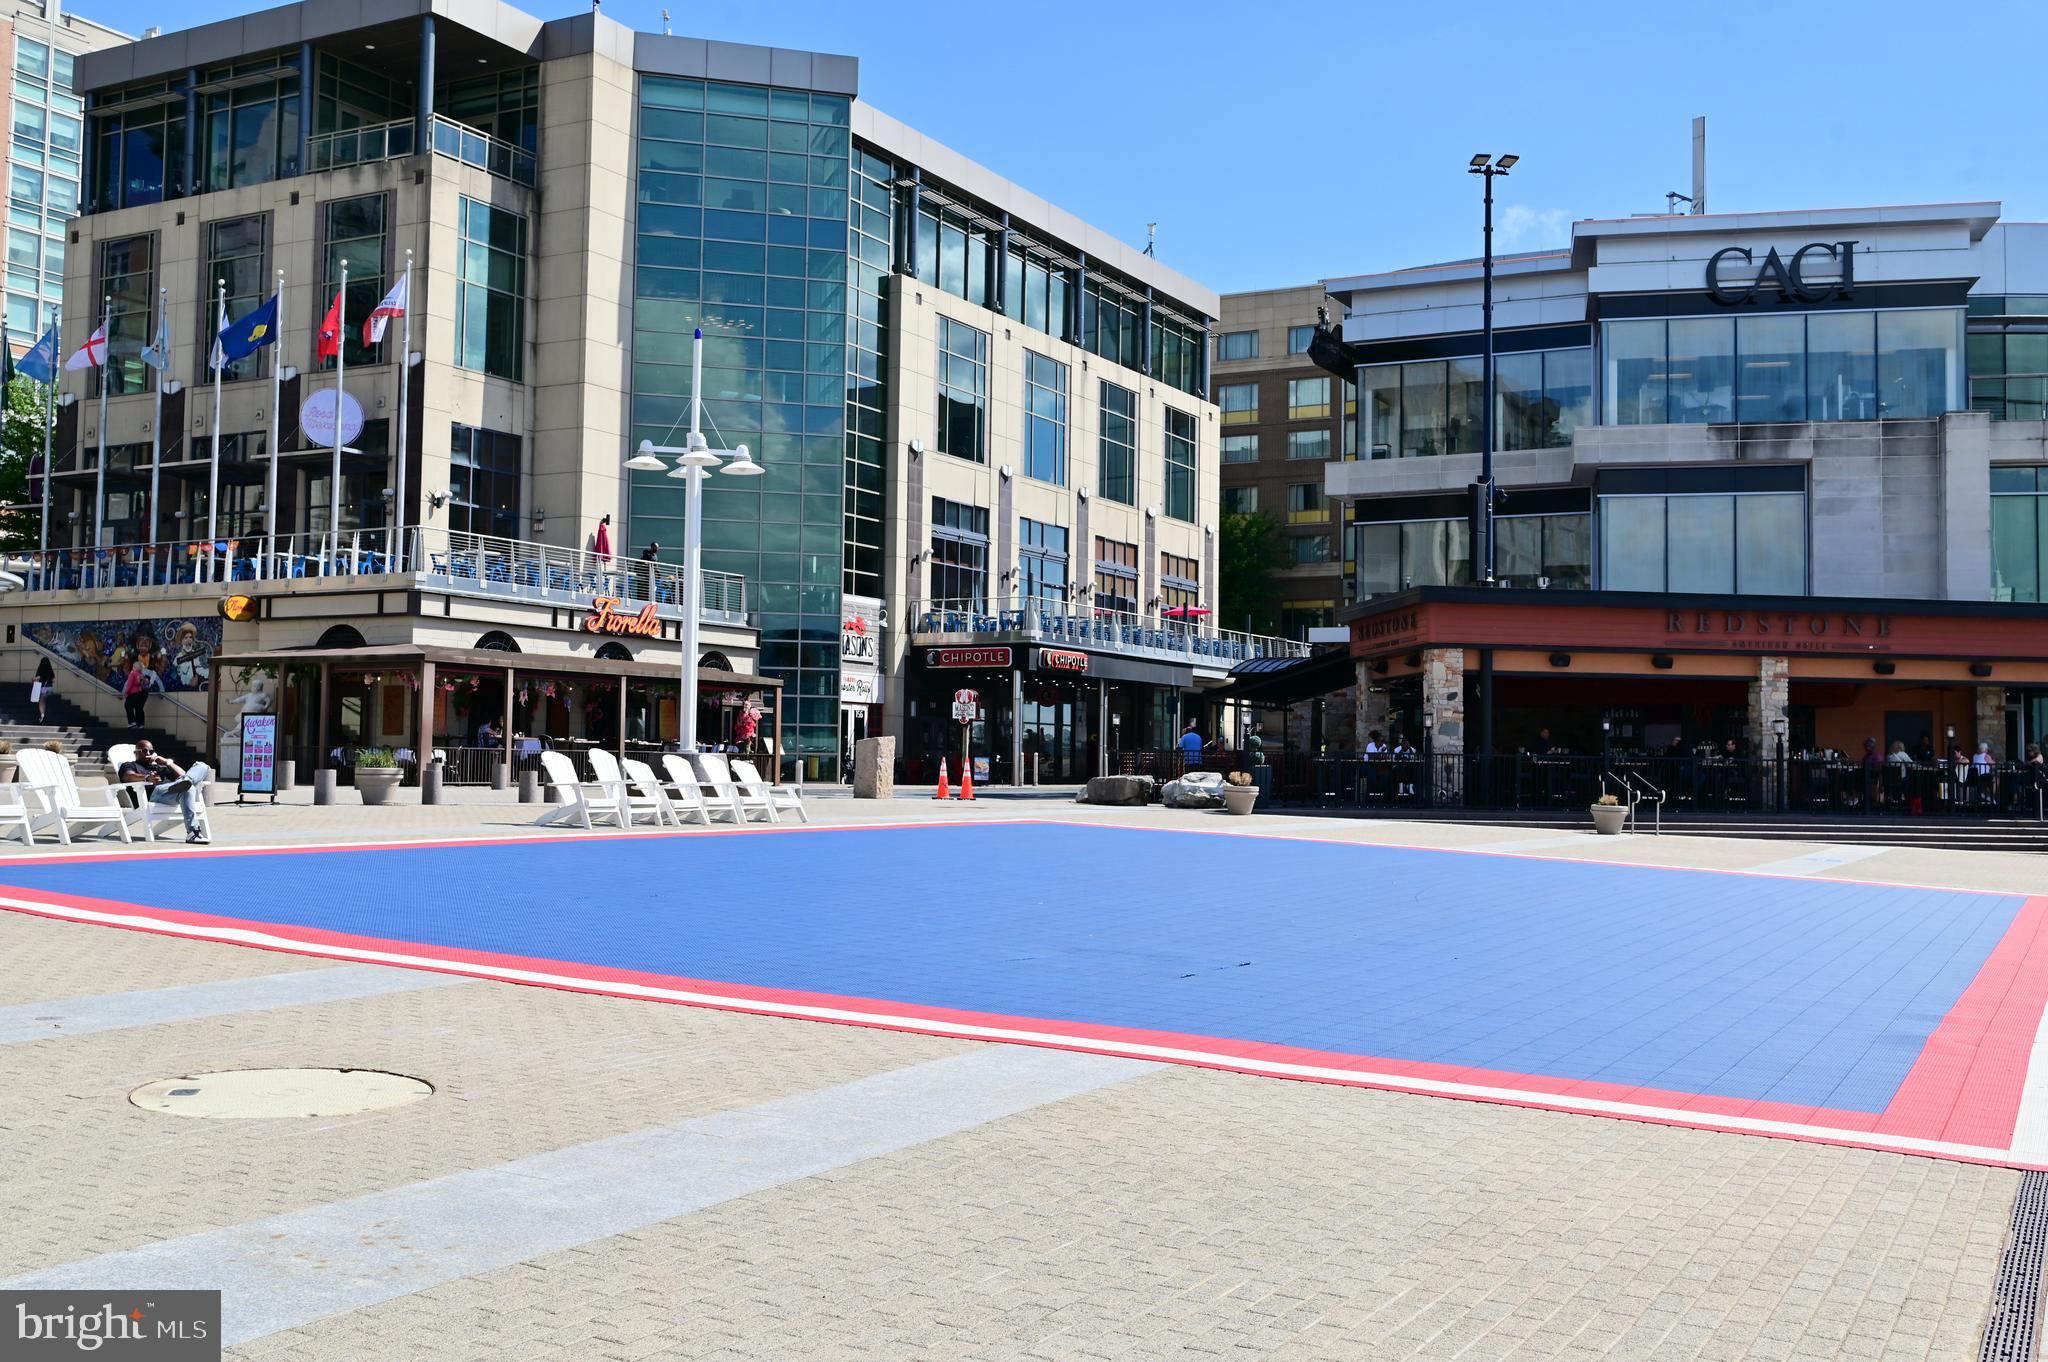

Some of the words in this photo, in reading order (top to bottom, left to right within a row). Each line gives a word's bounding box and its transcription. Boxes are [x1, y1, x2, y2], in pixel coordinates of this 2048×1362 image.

[1706, 241, 1859, 303] CACI
[586, 597, 662, 635] Fiorella
[1667, 613, 1892, 637] REDSTONE
[942, 652, 1004, 662] CHIPOTLE
[1055, 655, 1088, 667] CHIPOTLE
